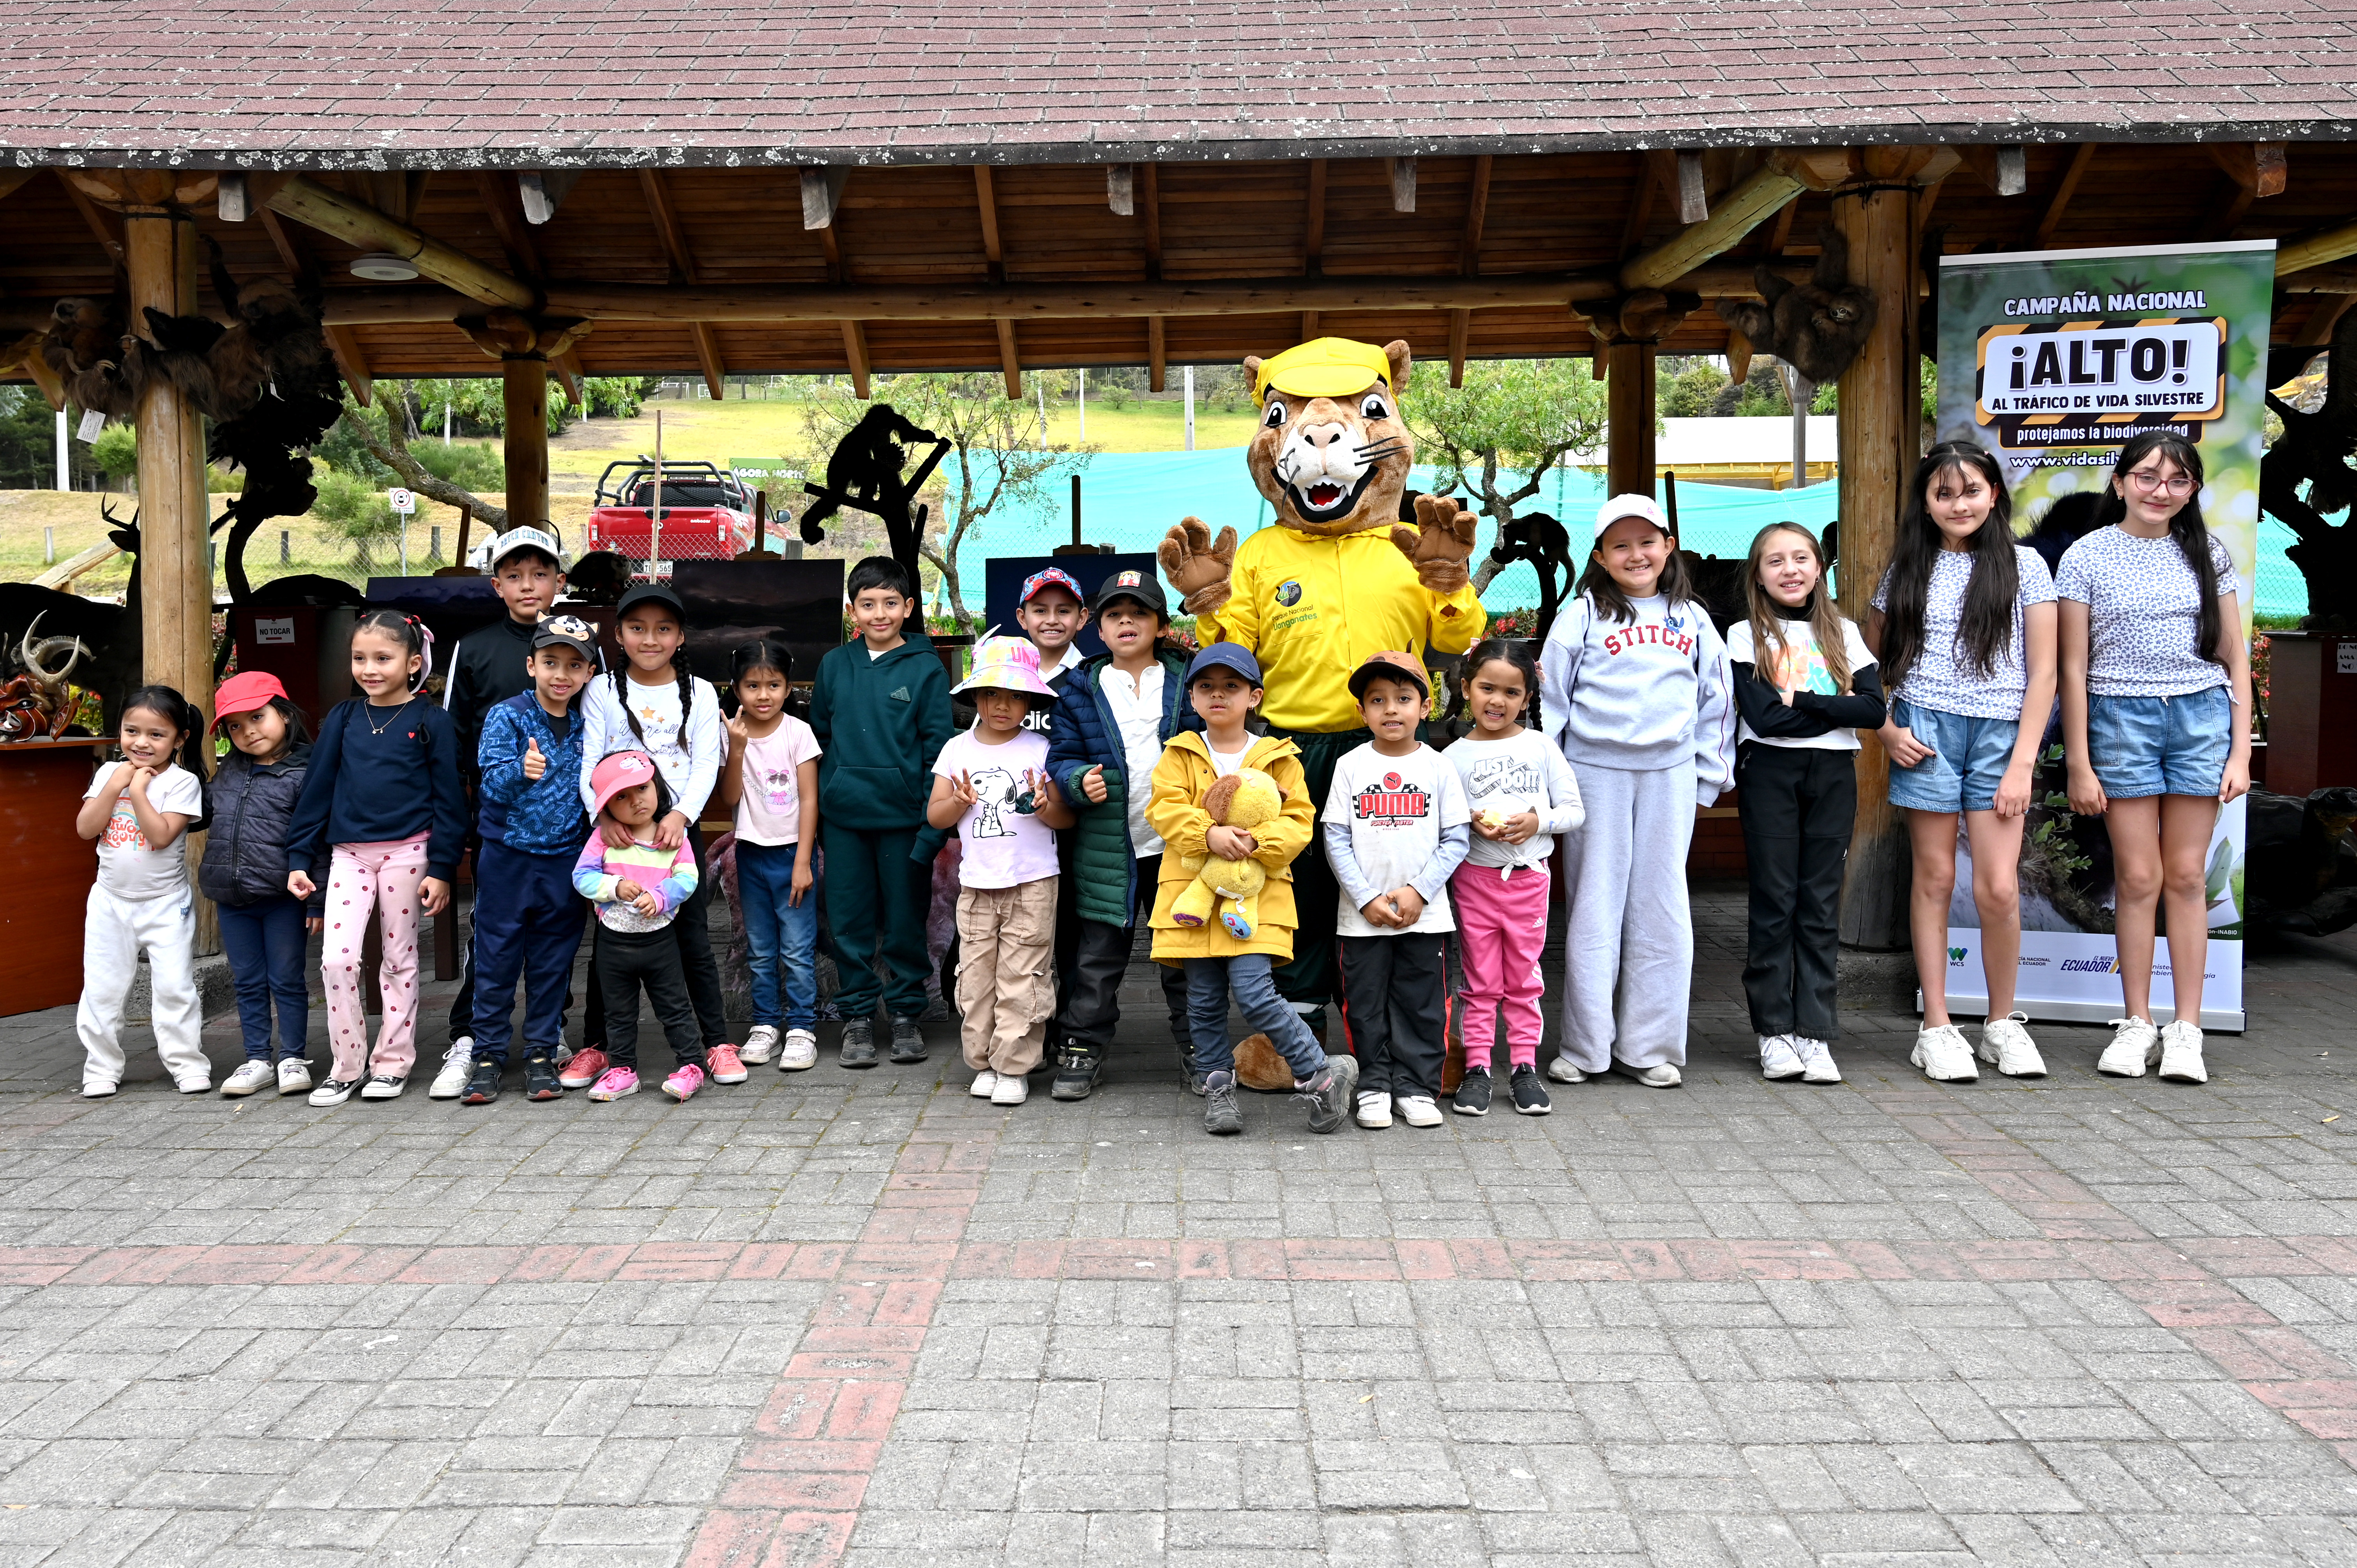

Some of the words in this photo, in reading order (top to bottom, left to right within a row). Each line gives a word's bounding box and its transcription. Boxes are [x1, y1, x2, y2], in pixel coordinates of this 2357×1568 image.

[2004, 291, 2101, 315] CAMPAÑA
[2108, 291, 2207, 311] NACIONAL
[2009, 337, 2188, 390] ¡ALTO!
[1992, 398, 2008, 410] AL
[2013, 395, 2069, 409] TRÁFICO
[2074, 396, 2090, 408] DE
[2096, 394, 2129, 407] VIDA
[2135, 392, 2204, 406] SILVESTRE
[2017, 427, 2085, 445] protejamos
[2089, 426, 2099, 439] la
[1272, 612, 1288, 622] Parque
[1288, 604, 1314, 615] Nacional
[1273, 613, 1318, 631] Llanganates
[1604, 625, 1693, 656] STITCH
[664, 724, 679, 735] all
[1473, 755, 1514, 781] JUST
[1360, 793, 1426, 817] PUMA
[109, 817, 137, 833] Two
[2060, 959, 2111, 973] ECUADOR
